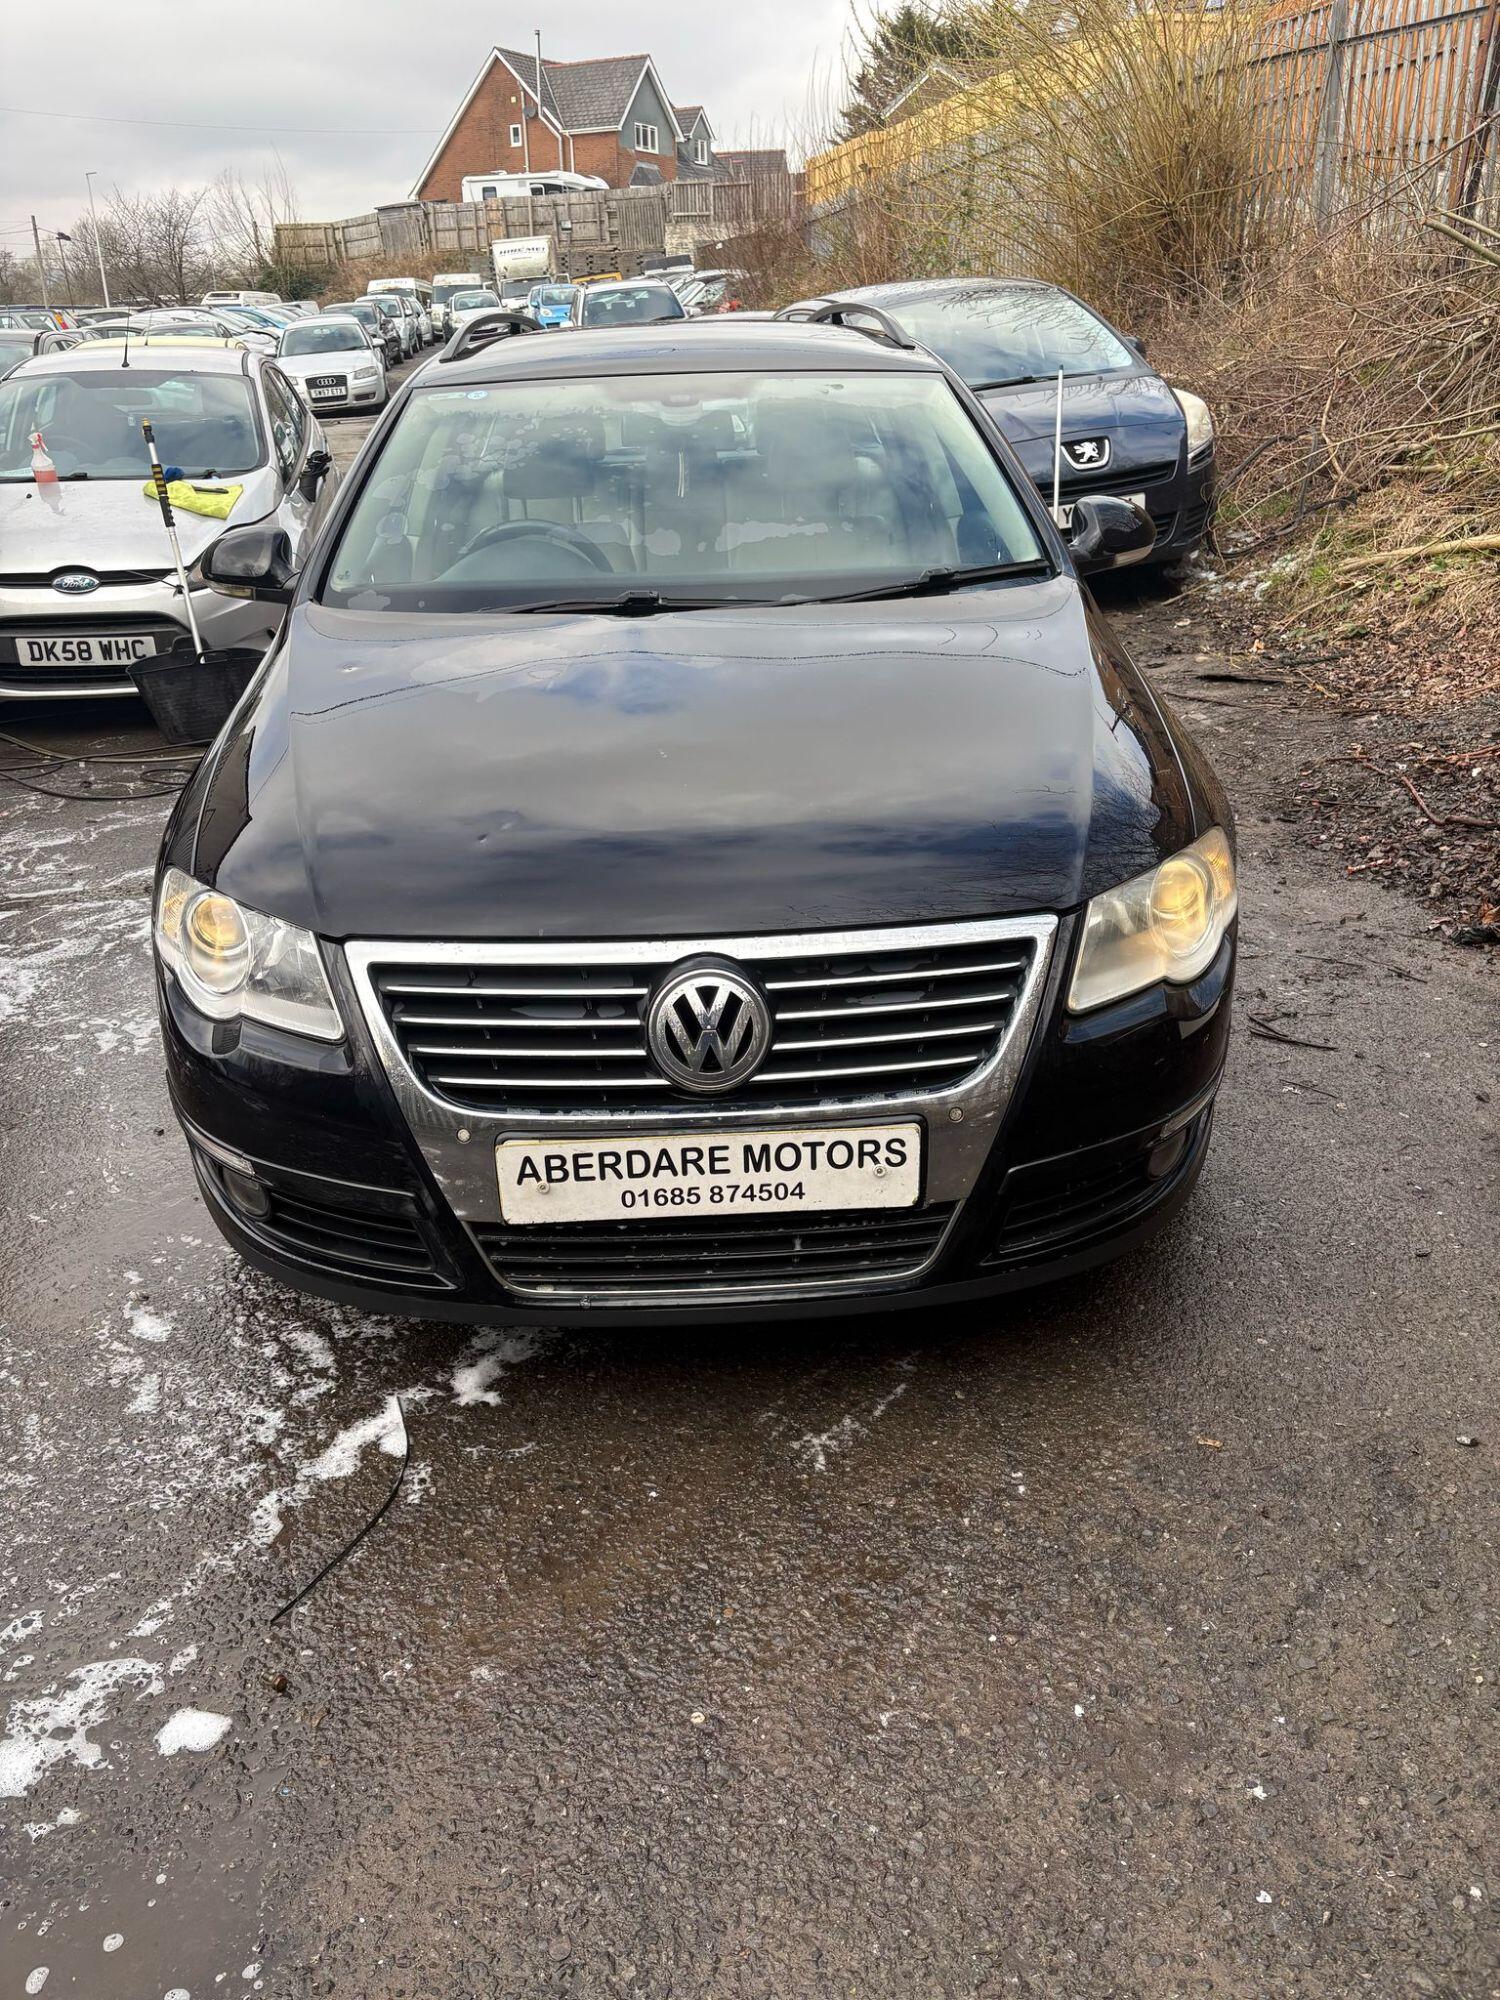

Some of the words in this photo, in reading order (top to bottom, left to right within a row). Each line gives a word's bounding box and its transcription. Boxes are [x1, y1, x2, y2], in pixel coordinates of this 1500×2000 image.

[27, 641, 93, 662] DK58
[98, 639, 147, 661] WHC
[517, 1145, 731, 1186] ABERDARE
[743, 1138, 908, 1175] MOTORS
[621, 1186, 700, 1209] 01685
[709, 1181, 806, 1204] 874504
